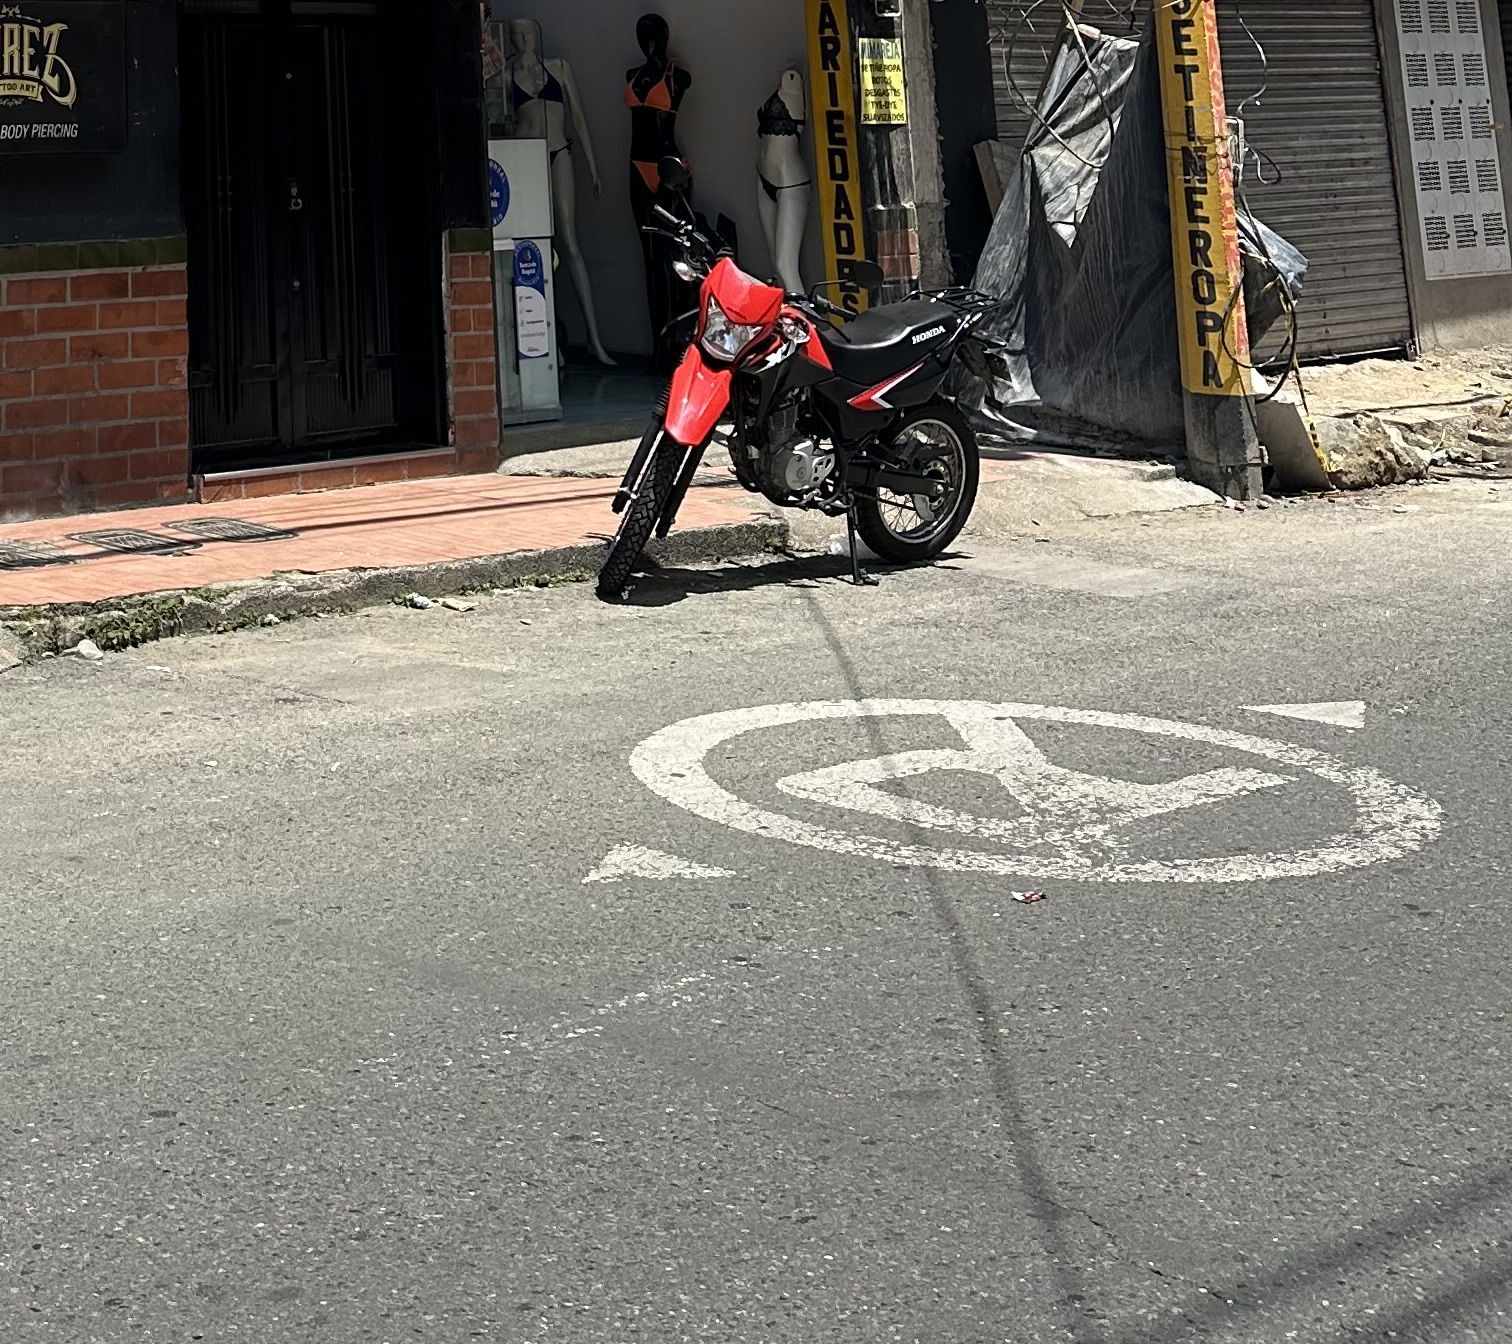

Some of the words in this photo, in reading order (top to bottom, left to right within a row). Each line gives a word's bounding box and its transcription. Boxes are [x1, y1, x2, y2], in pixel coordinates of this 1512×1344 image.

[19, 83, 36, 93] ART
[0, 124, 31, 140] BODY
[31, 123, 79, 139] PIERCING
[912, 323, 947, 346] HONDA
